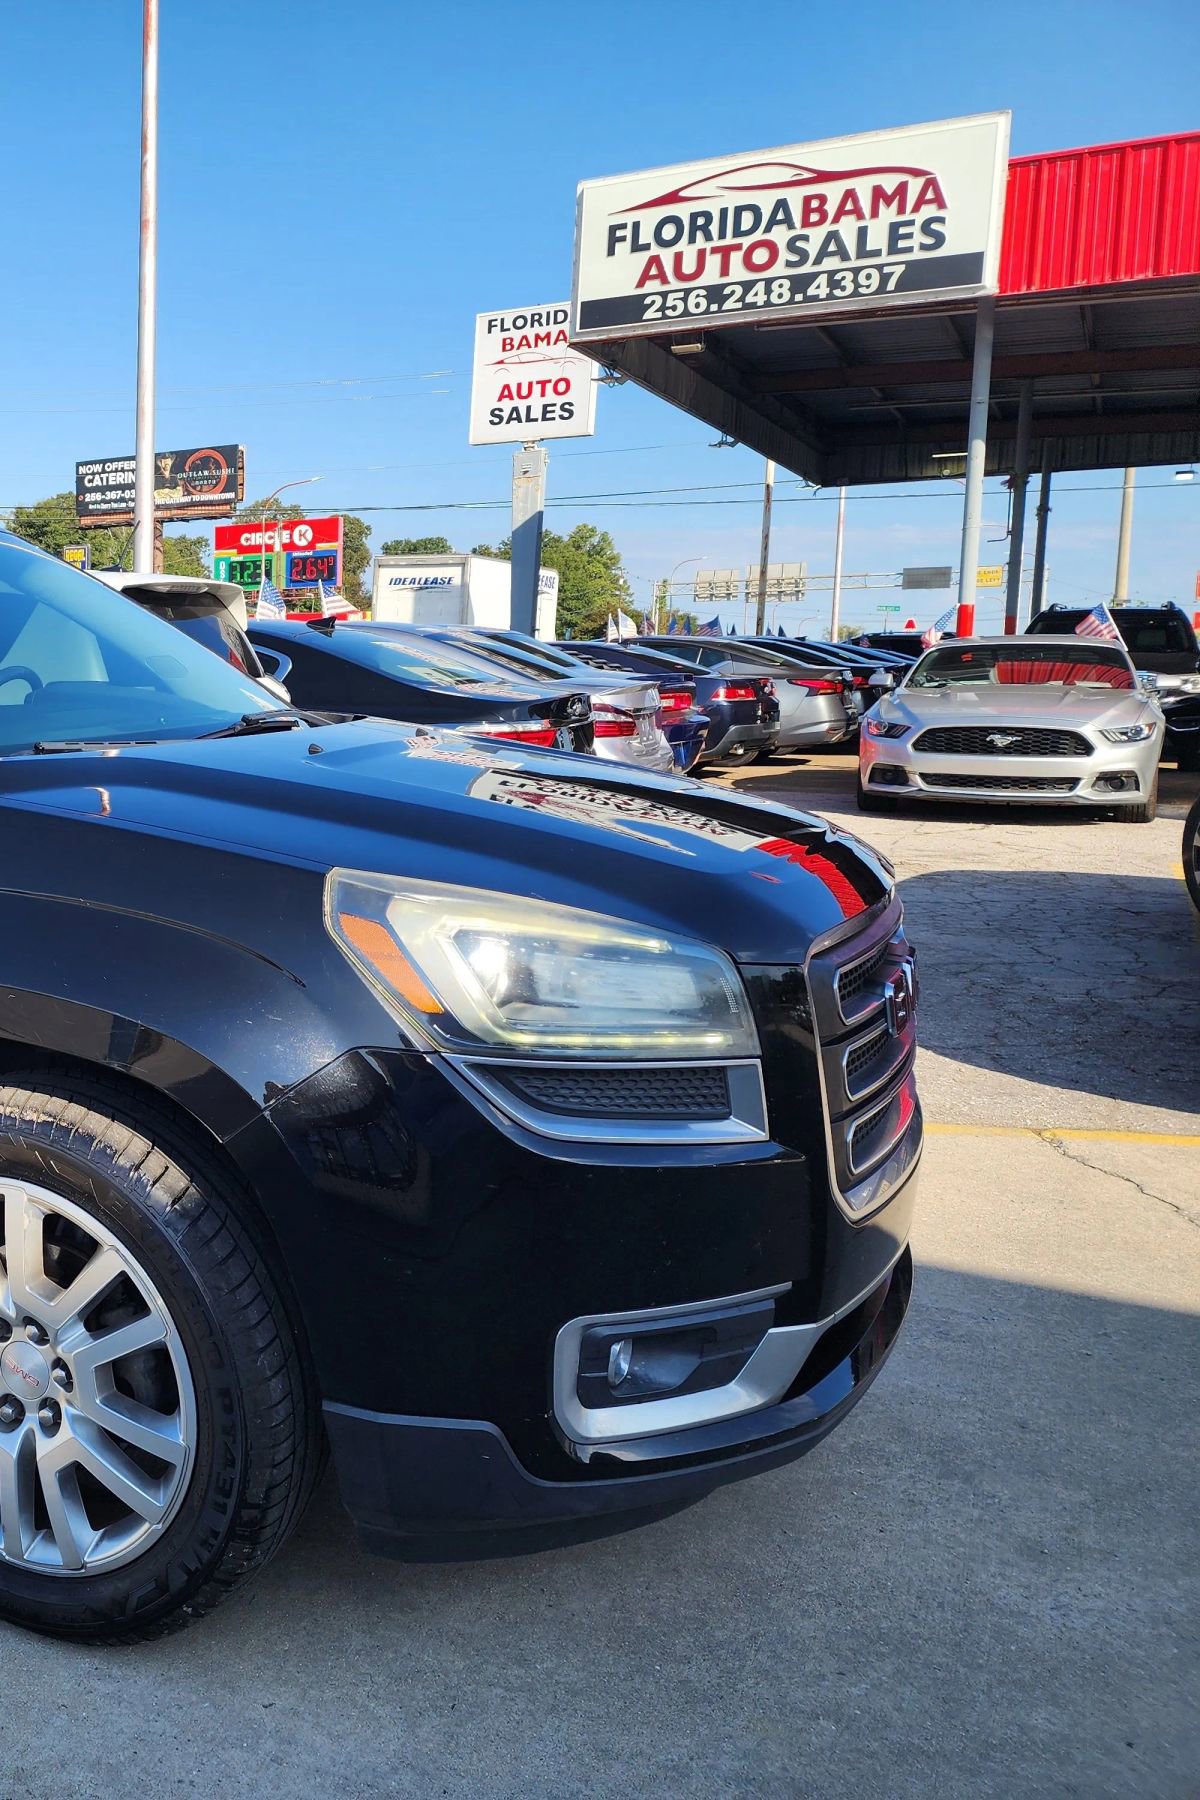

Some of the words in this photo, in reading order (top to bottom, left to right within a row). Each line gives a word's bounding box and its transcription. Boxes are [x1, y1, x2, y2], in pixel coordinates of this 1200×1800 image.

[642, 264, 906, 321] 256.248.4397
[487, 309, 569, 334] FLORID
[502, 329, 568, 353] BAMA
[497, 377, 571, 402] AUTO
[489, 401, 575, 426] SALES
[79, 464, 103, 474] NOW
[105, 460, 136, 471] OFFER
[177, 469, 209, 479] OUTLAW
[213, 467, 235, 475] SUSHI
[84, 471, 136, 487] CATERIN
[85, 489, 136, 502] 256-367-03
[165, 496, 192, 504] GATEWAY
[201, 492, 235, 501] DOWNTOWN
[240, 530, 290, 546] CIRCE
[388, 576, 455, 586] IDEALEASE
